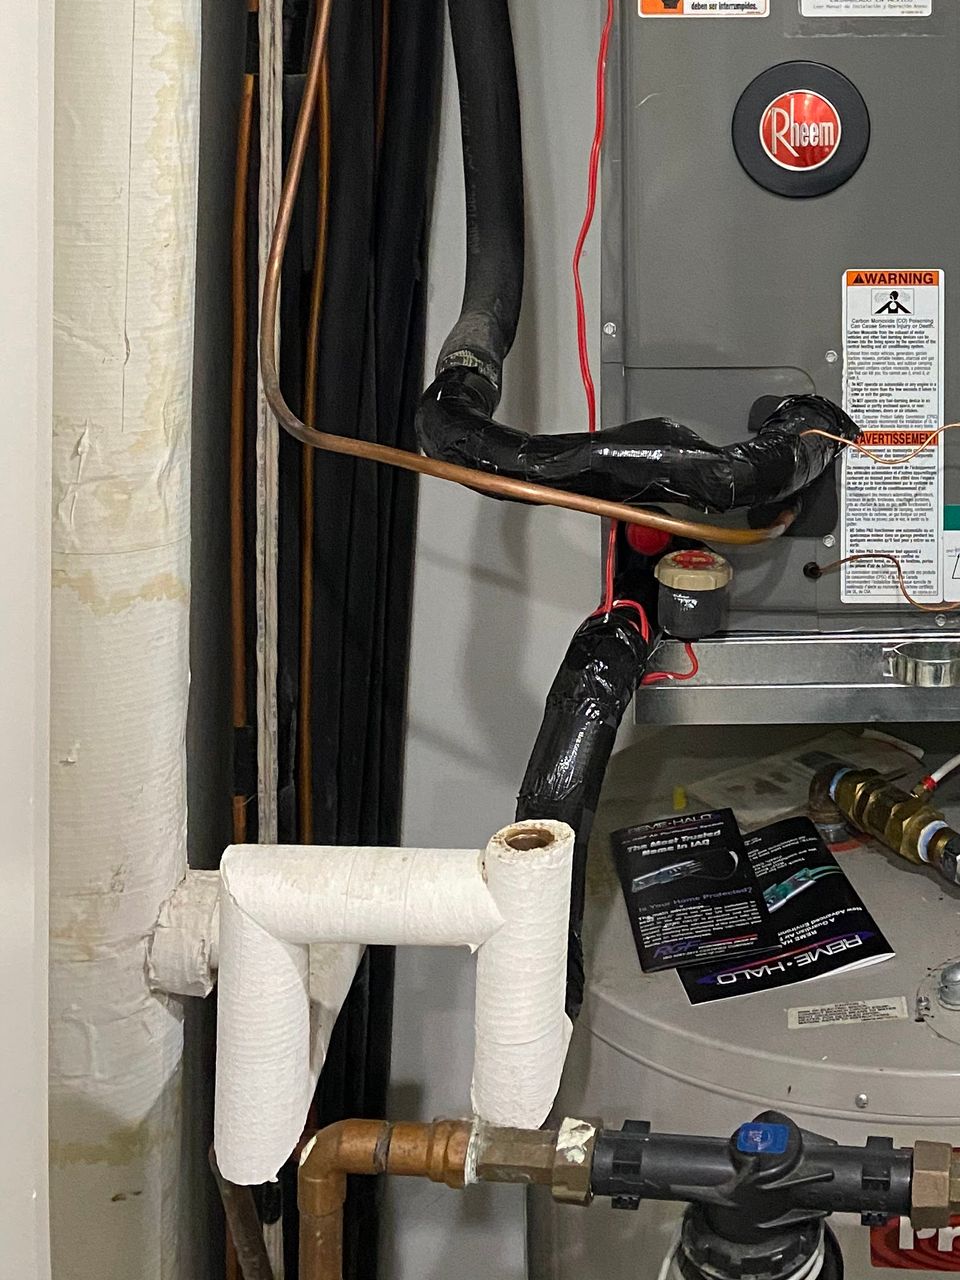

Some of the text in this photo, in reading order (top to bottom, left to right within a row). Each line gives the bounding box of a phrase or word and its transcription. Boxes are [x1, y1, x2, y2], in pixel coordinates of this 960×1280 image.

[692, 2, 707, 10] deben
[771, 96, 834, 157] Rheem
[865, 274, 933, 284] WARNING
[651, 838, 678, 848] Most
[681, 830, 721, 841] Trusted
[717, 934, 863, 985] REME HALO
